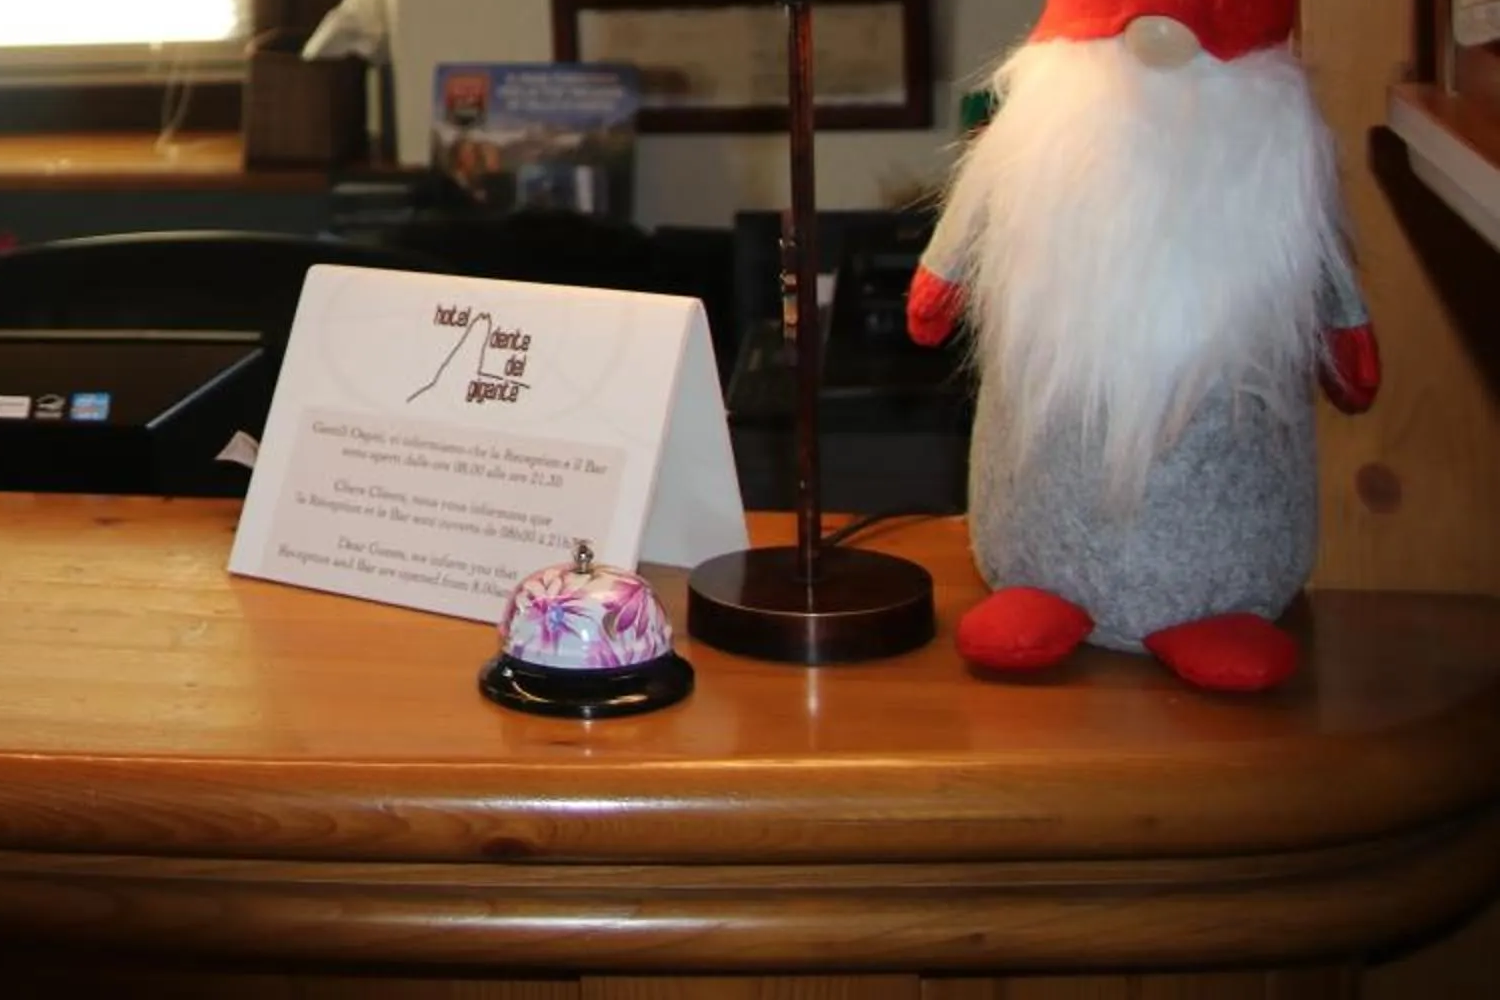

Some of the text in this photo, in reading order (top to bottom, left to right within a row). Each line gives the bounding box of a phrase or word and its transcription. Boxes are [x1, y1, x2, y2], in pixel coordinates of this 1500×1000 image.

[433, 302, 471, 327] hotel
[489, 326, 532, 351] dente
[504, 353, 527, 377] del
[466, 379, 519, 403] gigante
[504, 447, 562, 469] Reception
[585, 459, 608, 475] Bar
[332, 555, 355, 569] and
